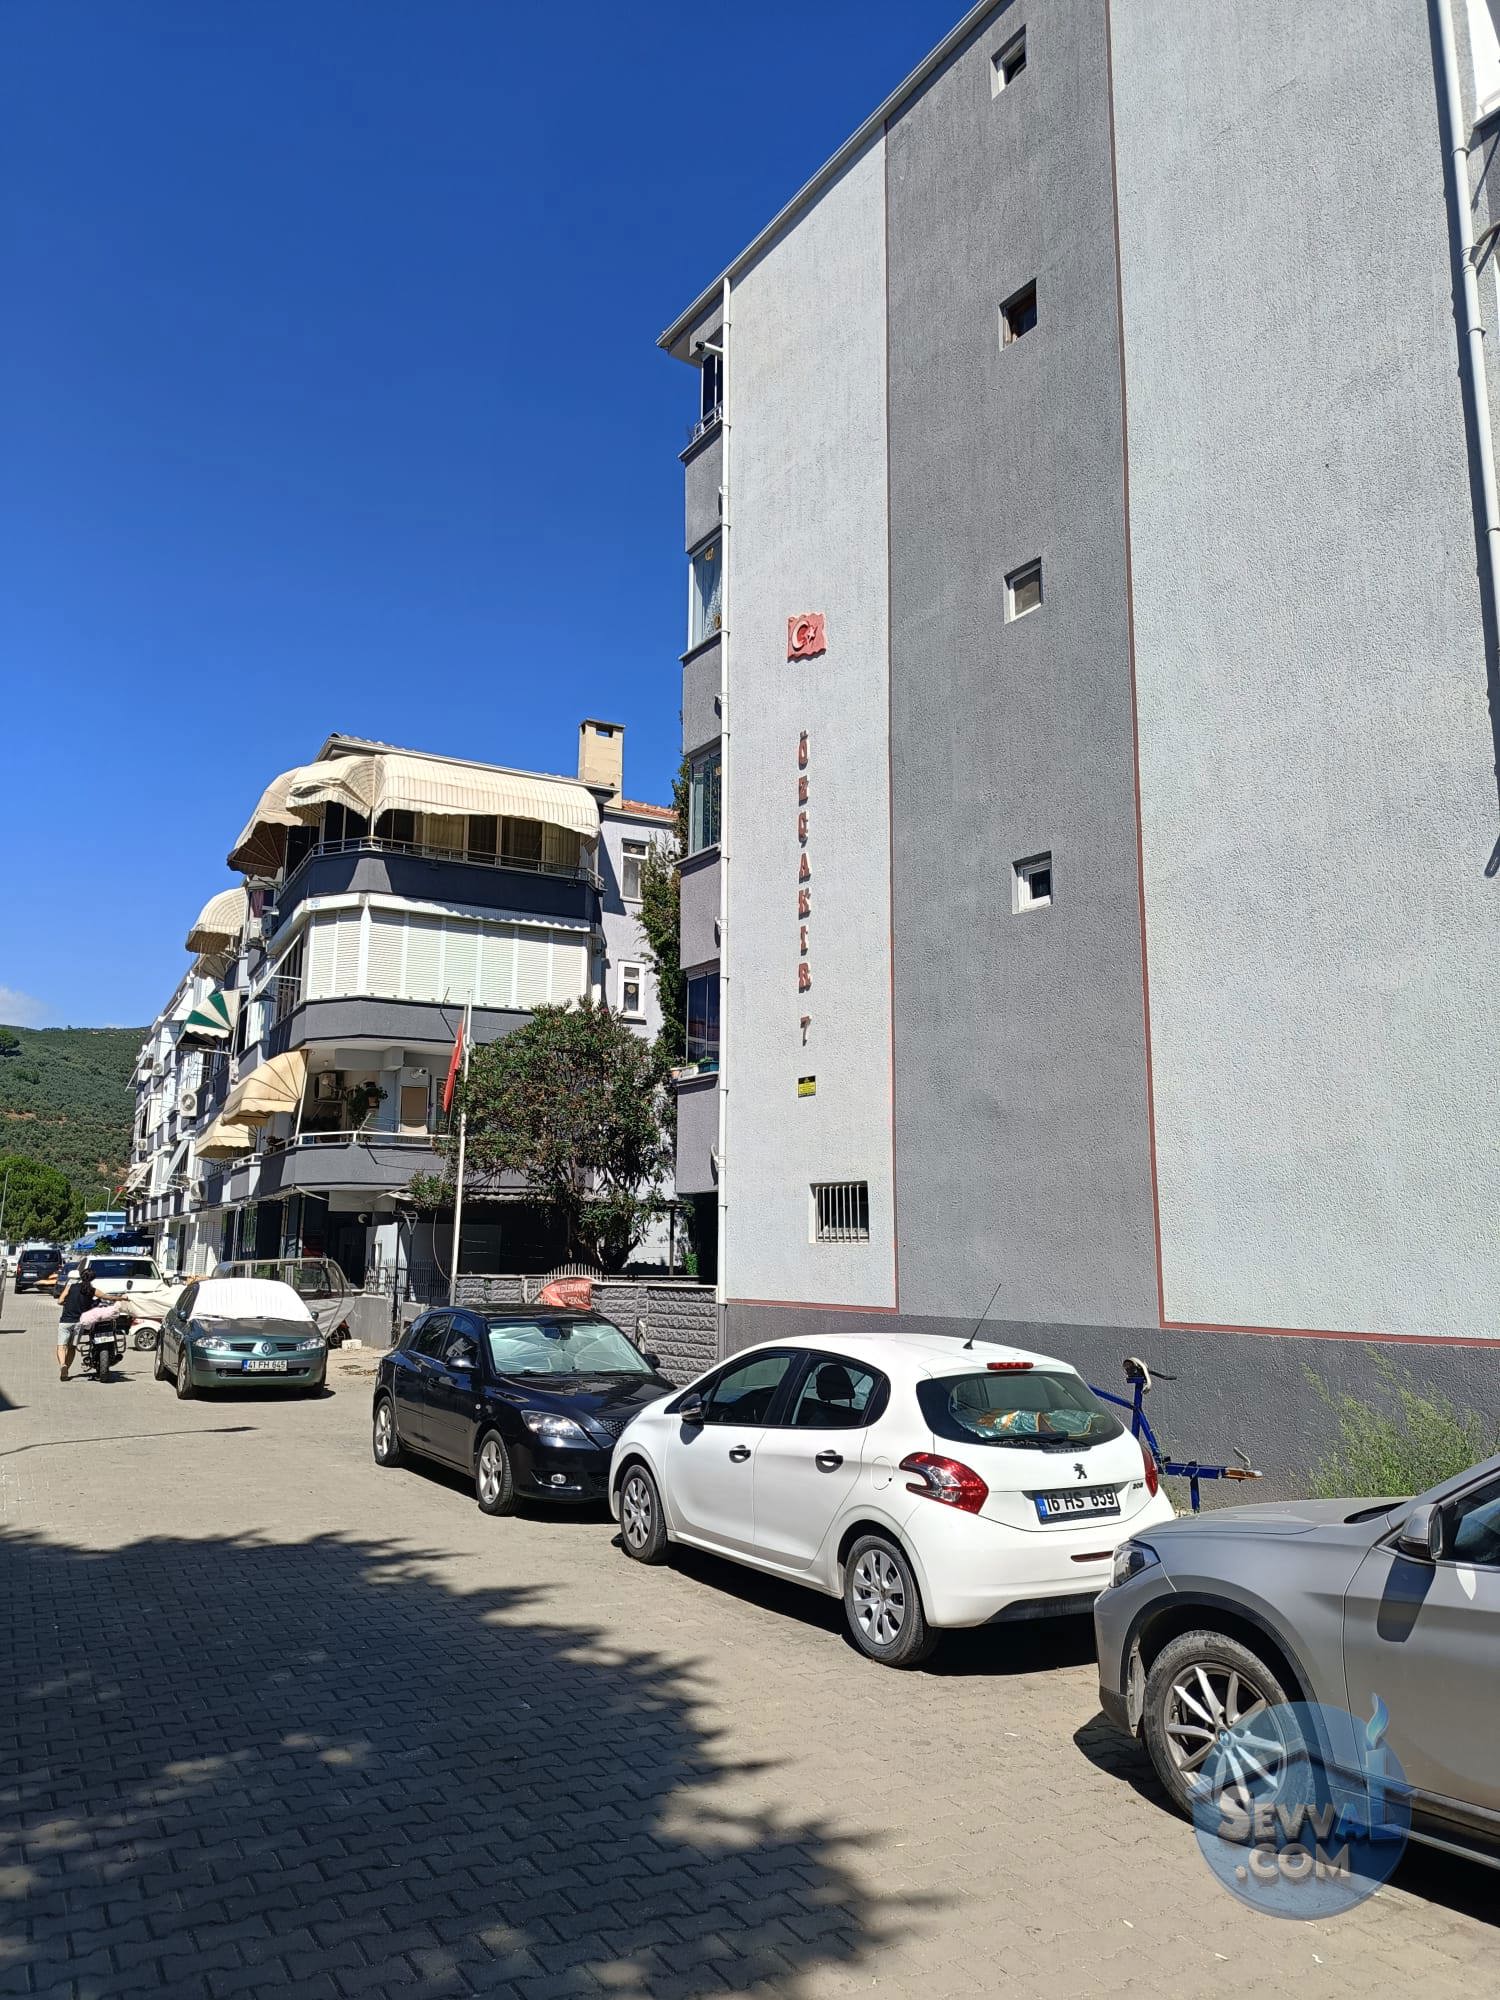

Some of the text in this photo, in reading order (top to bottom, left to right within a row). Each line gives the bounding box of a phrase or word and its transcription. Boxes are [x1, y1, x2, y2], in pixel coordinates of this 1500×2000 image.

[800, 1016, 812, 1046] 7
[1044, 1487, 1115, 1512] 16 HS 659
